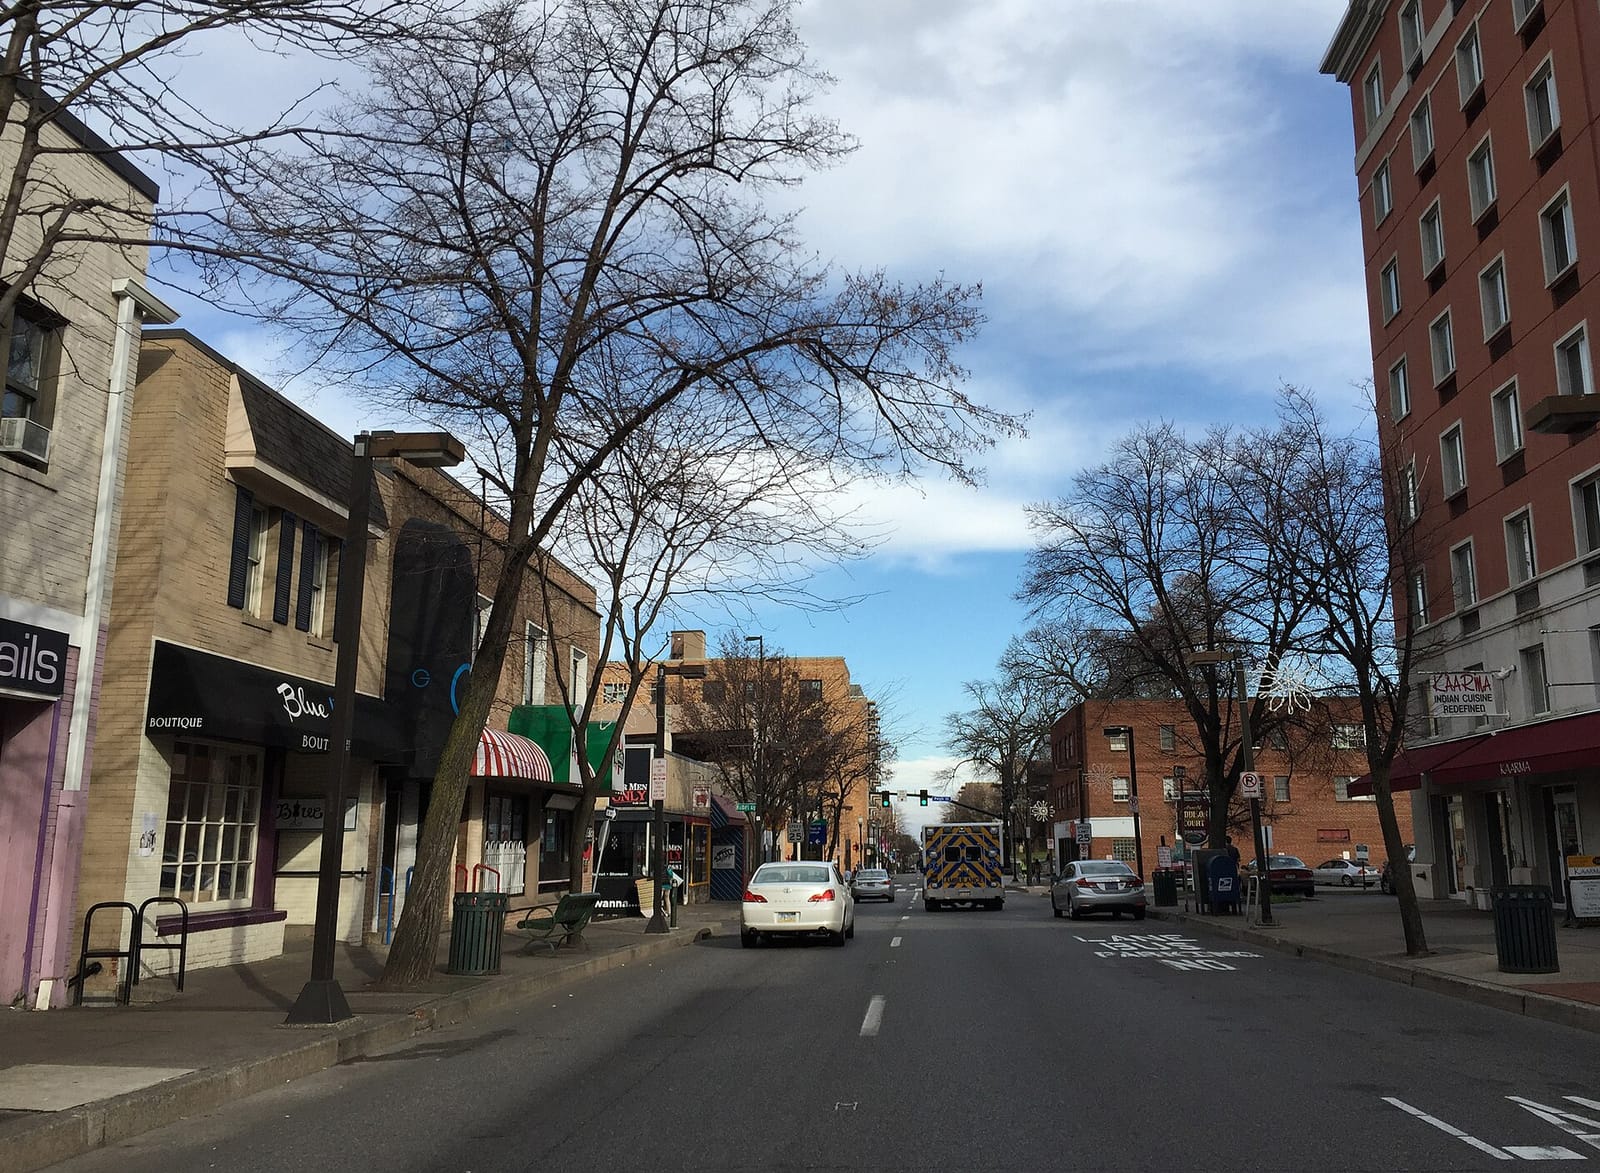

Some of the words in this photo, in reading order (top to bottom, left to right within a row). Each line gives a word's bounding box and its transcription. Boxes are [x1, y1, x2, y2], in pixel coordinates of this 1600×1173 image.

[1432, 673, 1492, 692] KAARMA
[276, 682, 329, 722] Blue
[1434, 694, 1459, 703] INDIAN
[1462, 693, 1493, 703] CUISINE
[1443, 704, 1486, 714] REDEFINED
[150, 717, 203, 729] BOUTIQUE
[1500, 761, 1531, 775] KAARMA
[629, 783, 648, 791] MEN
[789, 832, 802, 840] 25
[1077, 833, 1090, 842] 25
[1073, 934, 1197, 943] LANE
[1100, 942, 1201, 950] BUS
[1160, 959, 1237, 971] NO
